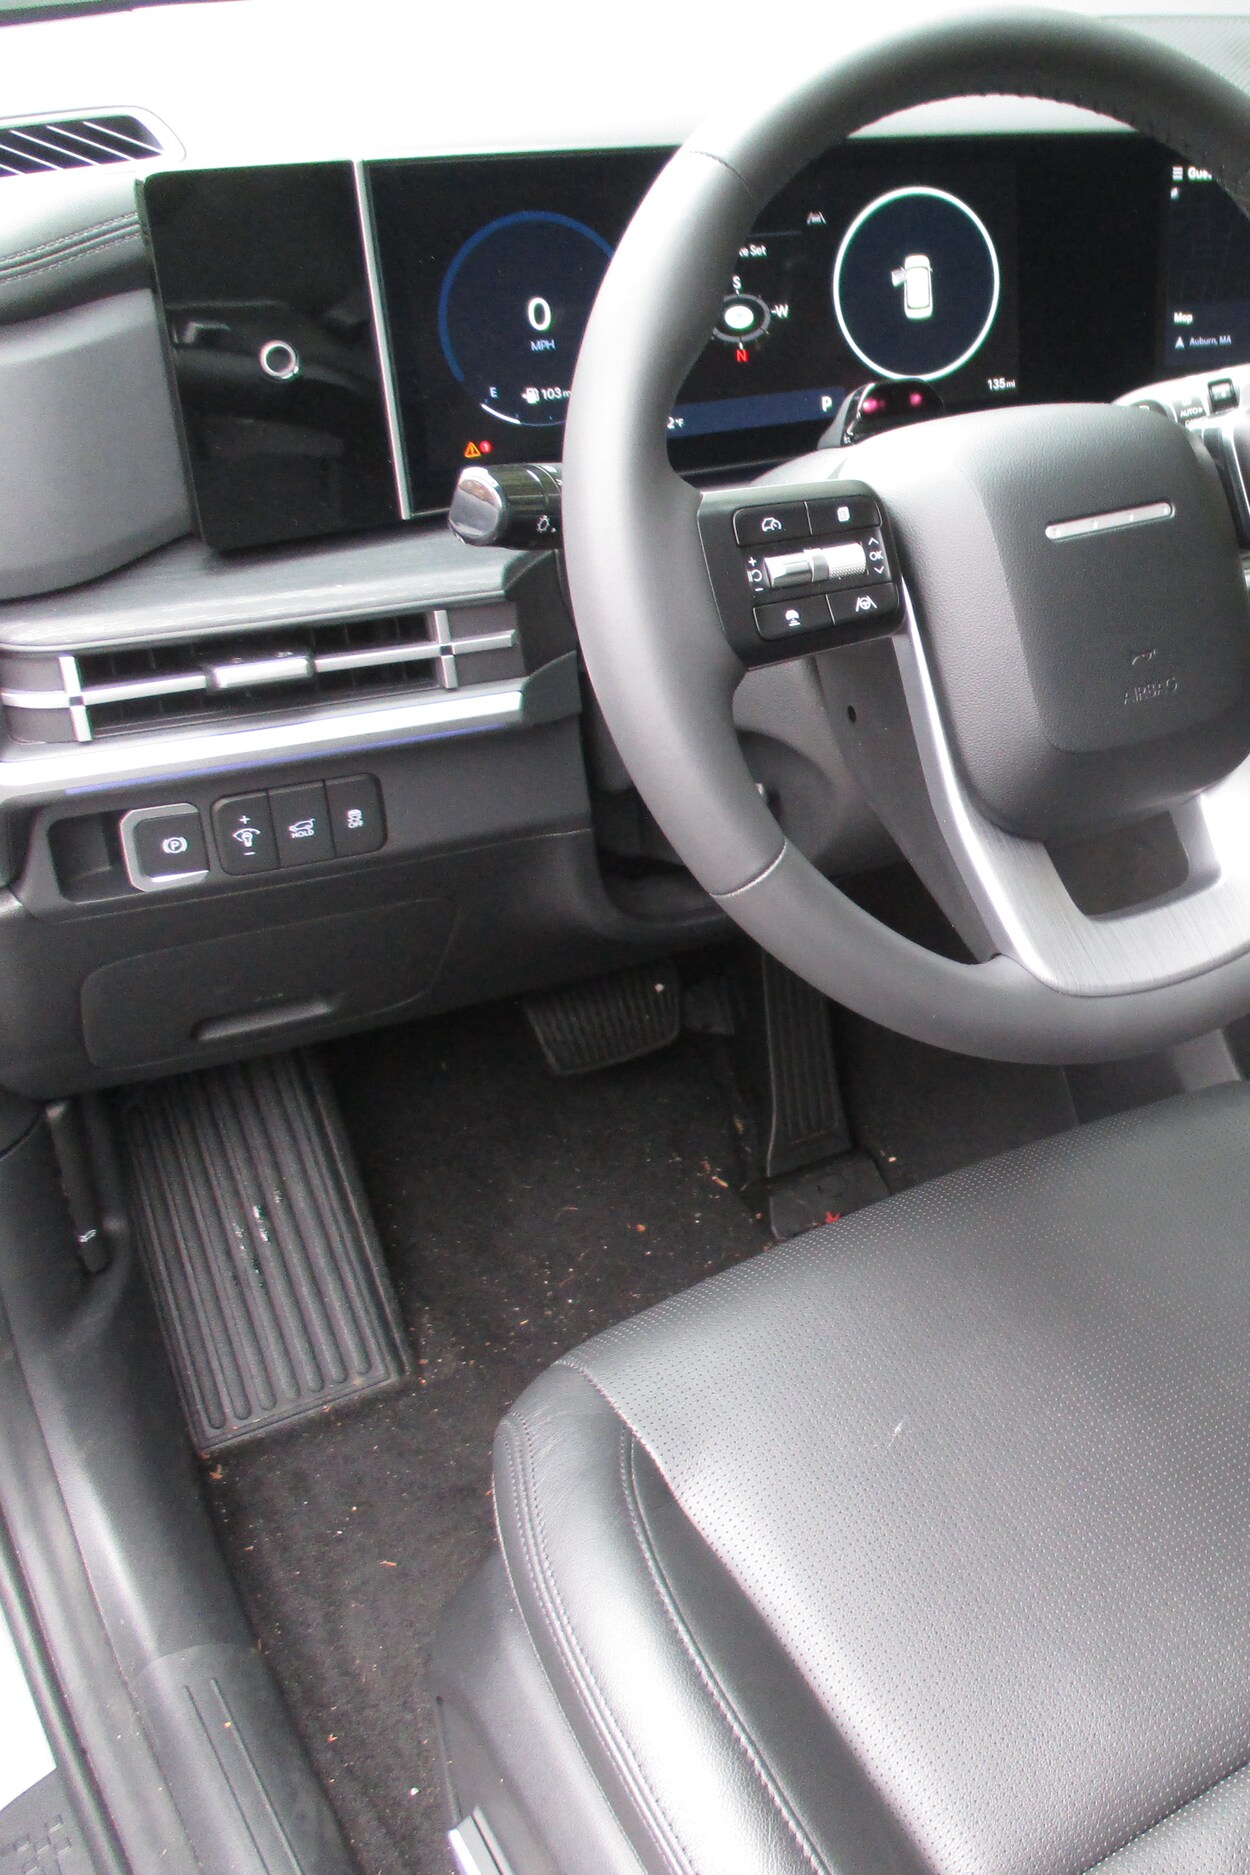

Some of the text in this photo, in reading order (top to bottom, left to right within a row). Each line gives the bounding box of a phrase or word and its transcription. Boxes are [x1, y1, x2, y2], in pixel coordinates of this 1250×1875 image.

[731, 274, 743, 290] S
[527, 297, 552, 331] 0
[530, 339, 557, 352] MPH
[1218, 336, 1232, 345] MA
[736, 350, 748, 363] N
[489, 387, 498, 399] E
[821, 396, 833, 413] P
[1180, 407, 1199, 417] AUTO
[869, 551, 884, 562] OK
[290, 829, 316, 840] HOLD
